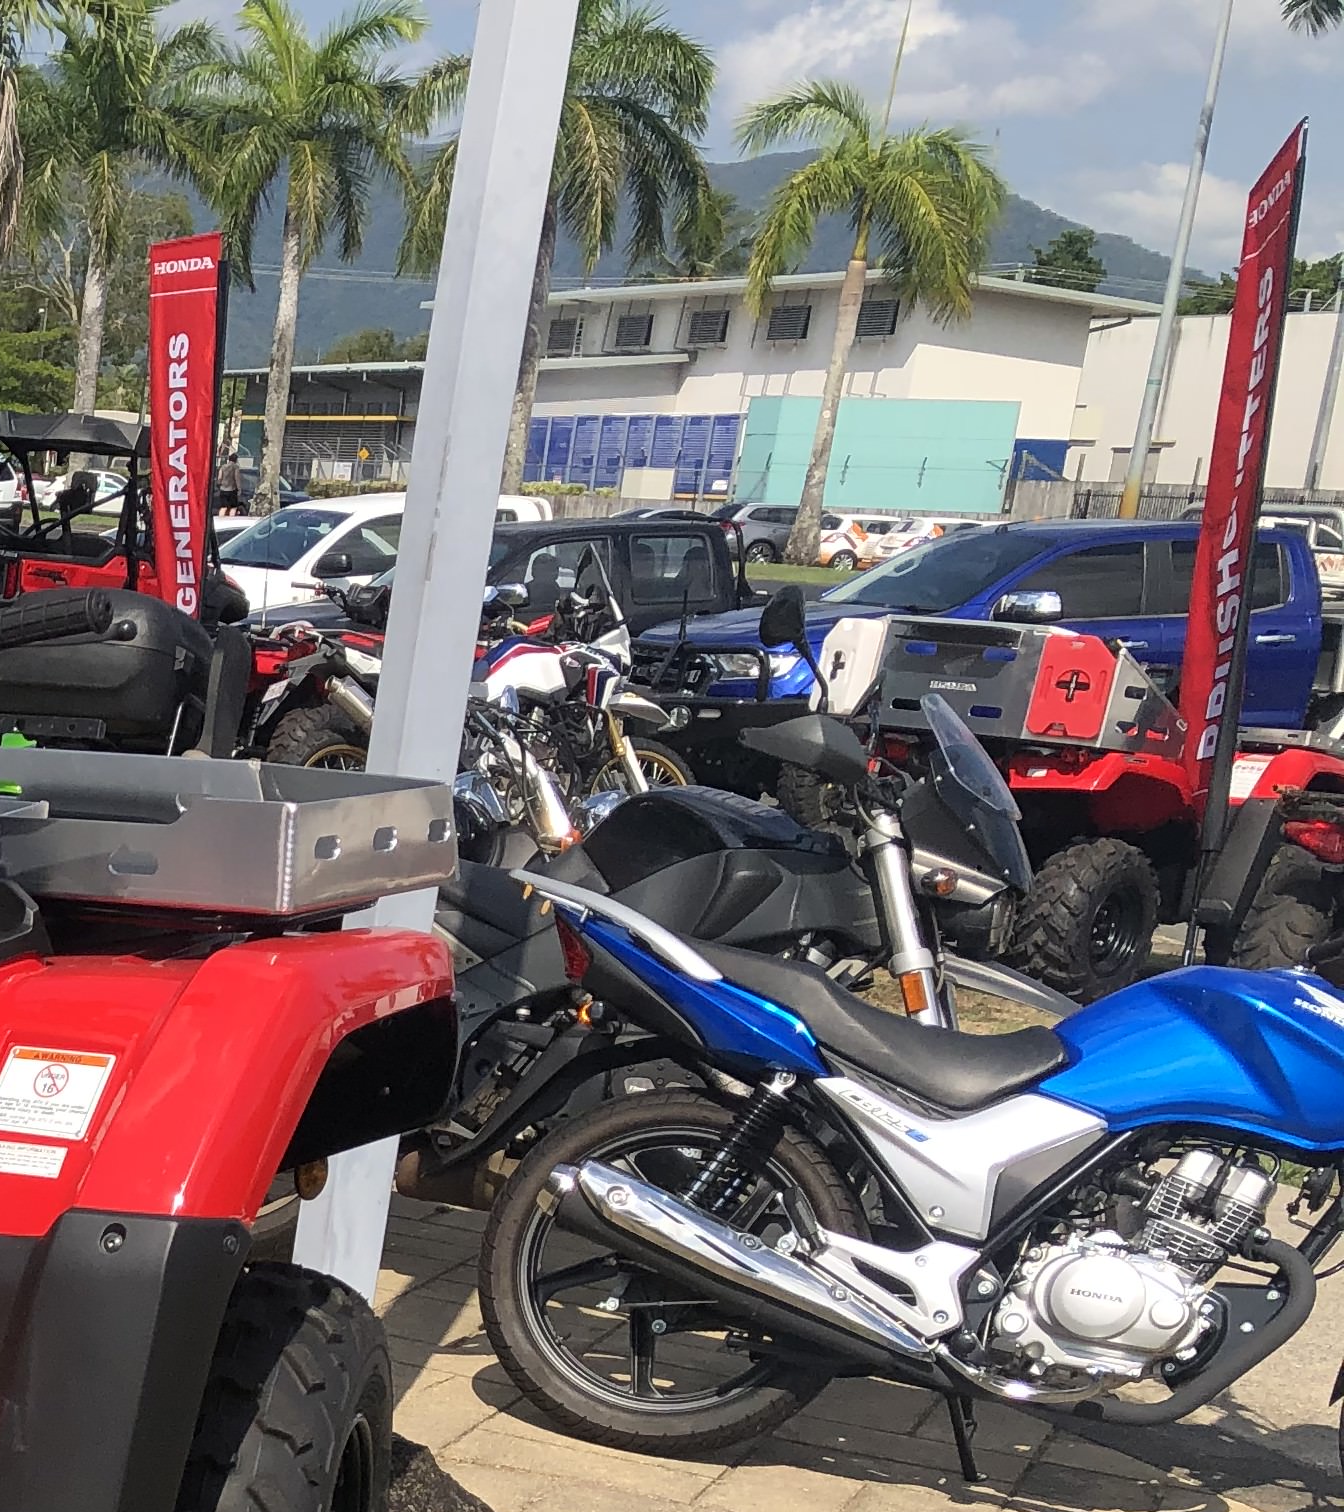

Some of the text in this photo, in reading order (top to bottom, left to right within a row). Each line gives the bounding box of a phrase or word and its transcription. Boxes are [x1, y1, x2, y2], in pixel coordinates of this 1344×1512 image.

[153, 256, 215, 276] HONDA
[168, 332, 198, 615] GENERATORS
[42, 1082, 54, 1094] 16
[1069, 1287, 1124, 1304] HONDA
